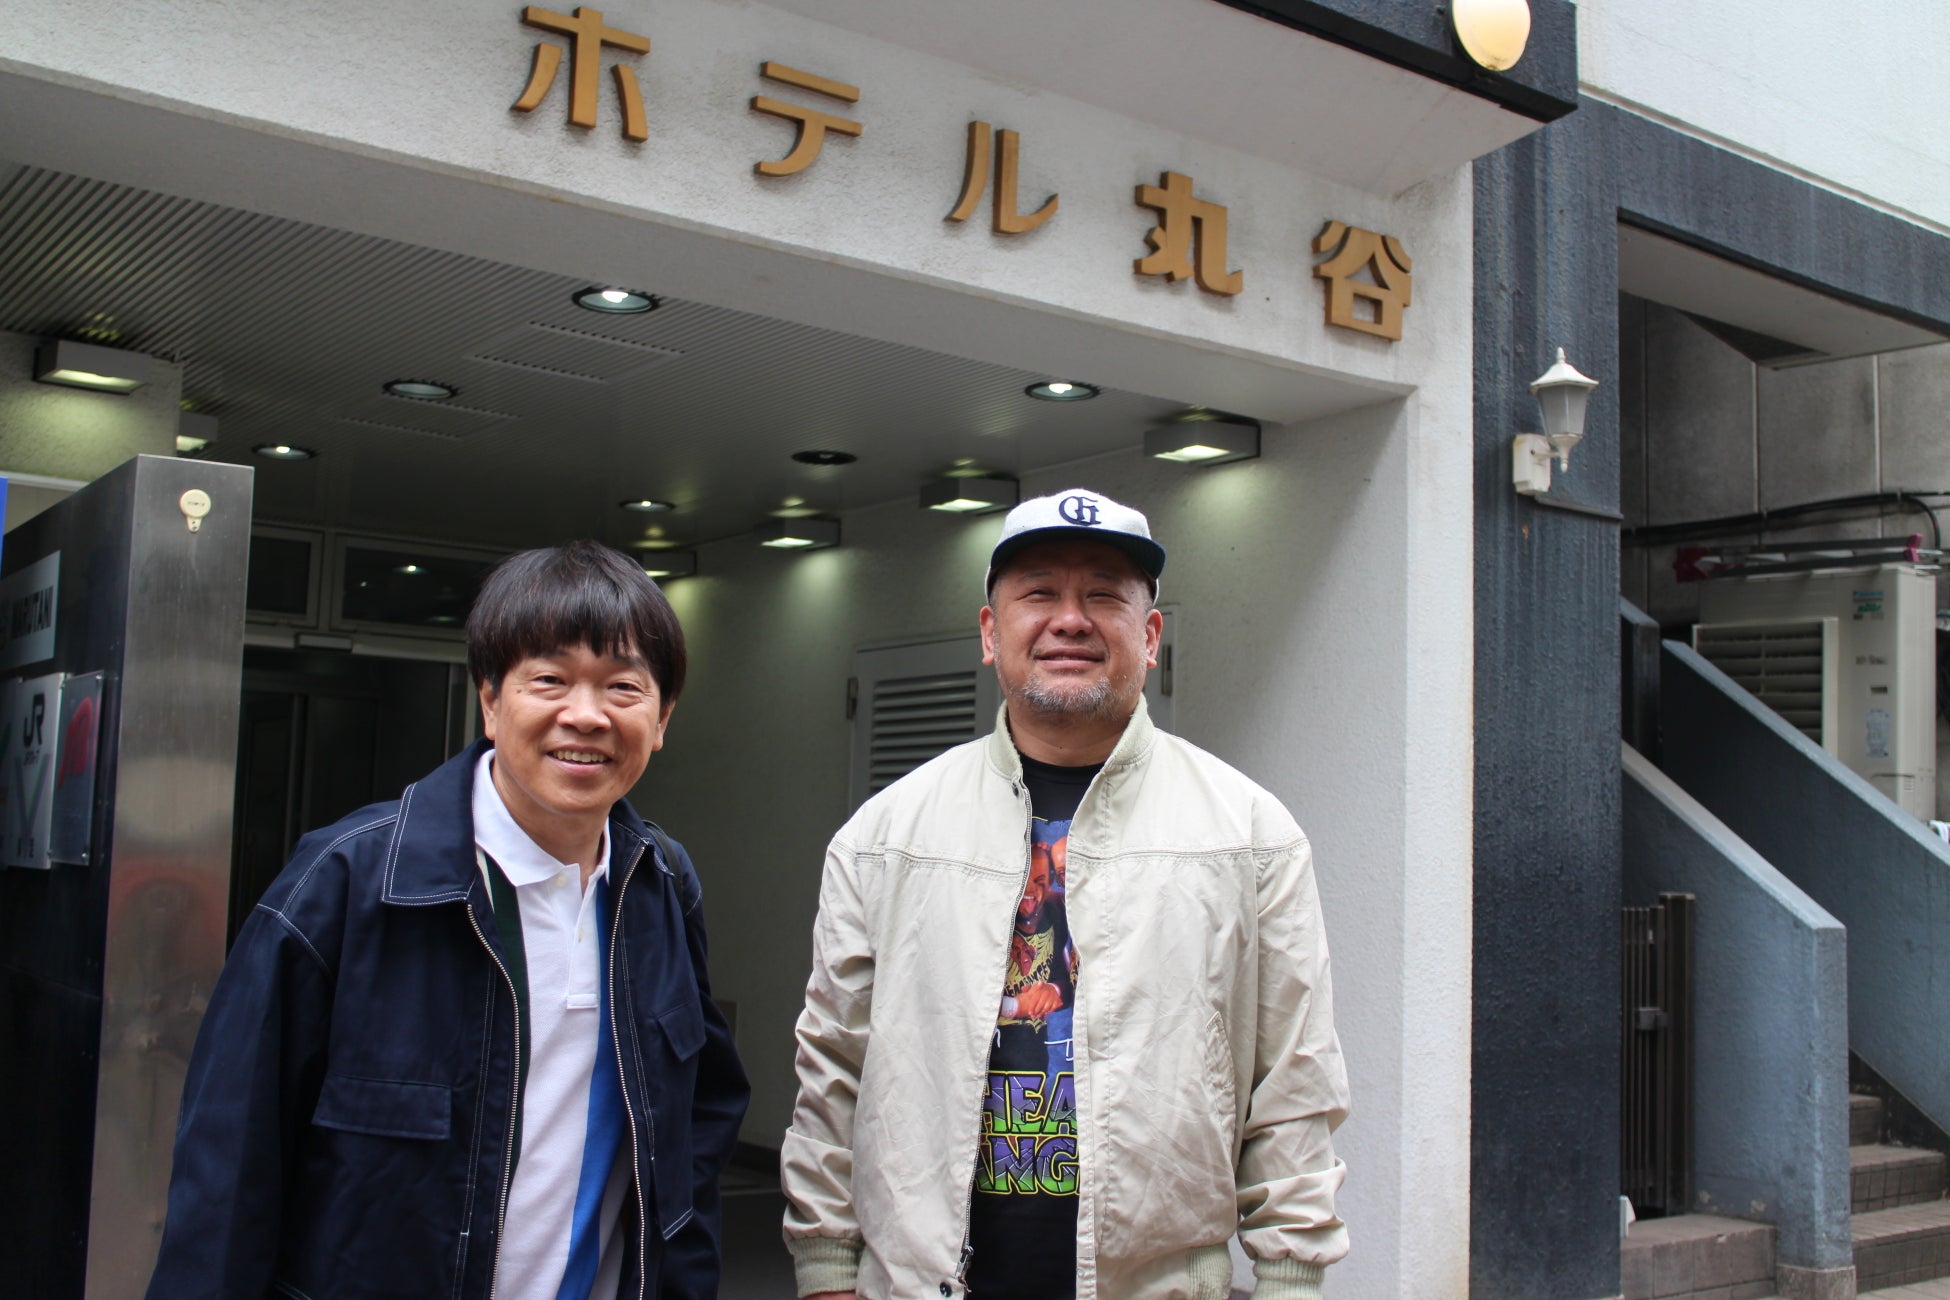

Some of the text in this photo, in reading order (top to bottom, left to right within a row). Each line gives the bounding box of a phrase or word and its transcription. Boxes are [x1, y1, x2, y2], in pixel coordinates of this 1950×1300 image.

[510, 5, 1413, 342] ホテル丸谷
